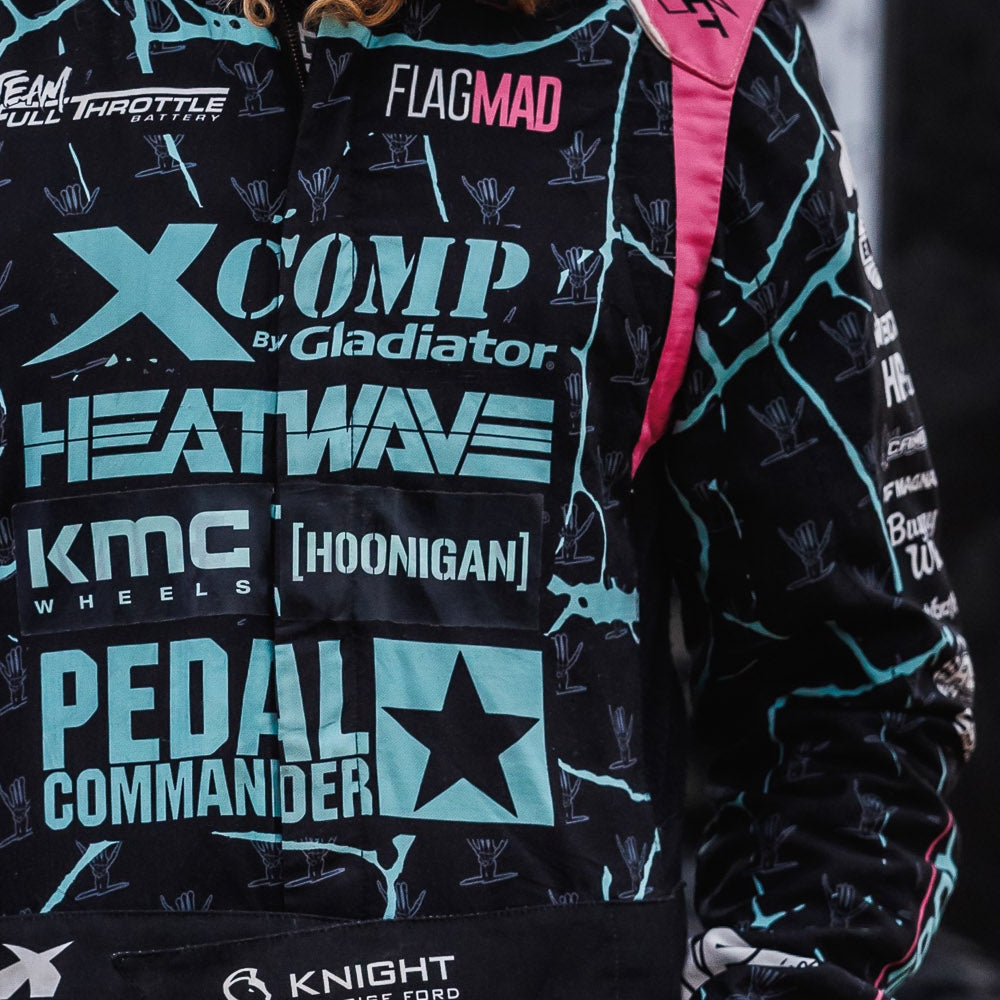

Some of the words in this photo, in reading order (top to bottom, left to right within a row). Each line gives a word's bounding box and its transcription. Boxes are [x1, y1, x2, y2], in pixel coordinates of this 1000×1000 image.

[66, 87, 230, 121] THROTTLE
[385, 63, 563, 133] FLAGMAD
[130, 113, 221, 123] BATTERY
[252, 331, 288, 352] By
[22, 384, 555, 488] HEATWAVE
[34, 580, 251, 614] WHEELS
[40, 638, 370, 771] PEDAL
[44, 757, 373, 831] COMMANDER
[289, 955, 455, 998] KNIGHT
[404, 987, 460, 1000] FORD
